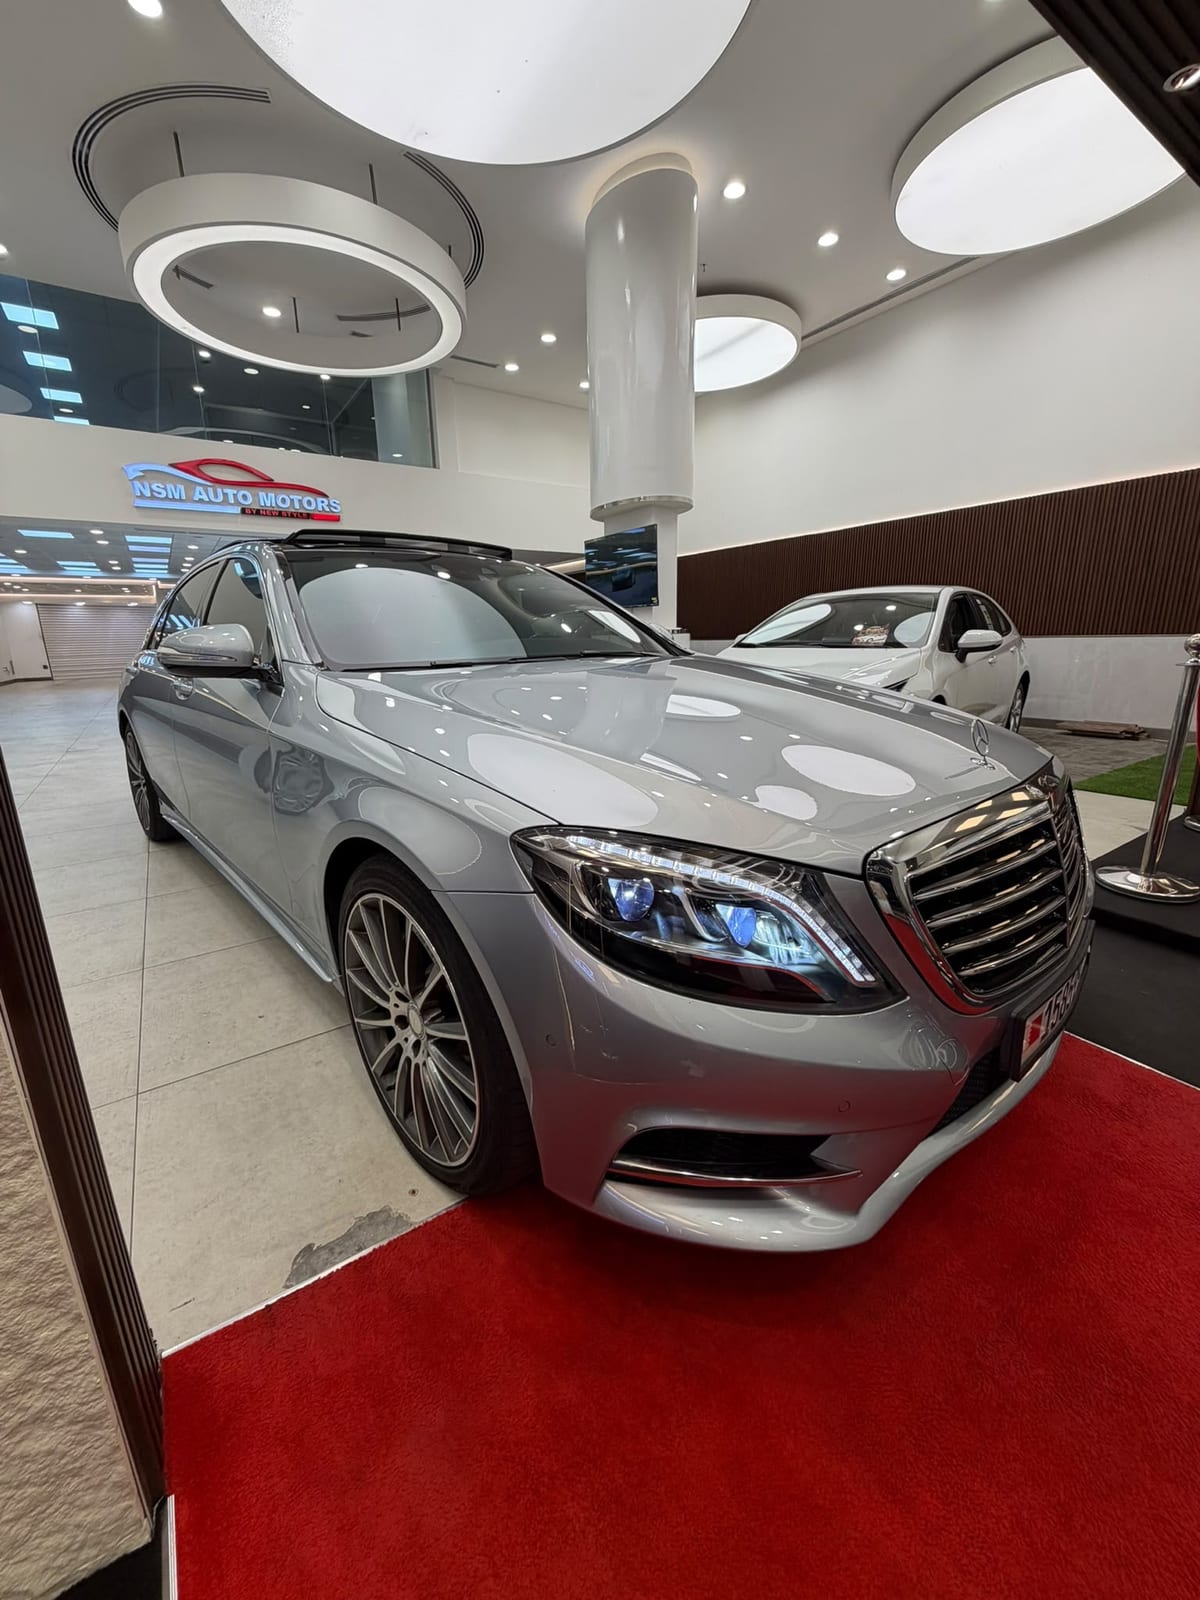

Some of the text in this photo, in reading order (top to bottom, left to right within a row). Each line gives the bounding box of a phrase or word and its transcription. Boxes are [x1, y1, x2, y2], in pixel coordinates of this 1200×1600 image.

[133, 480, 341, 513] NSM AUTO MOTORS
[281, 511, 309, 519] STYLE
